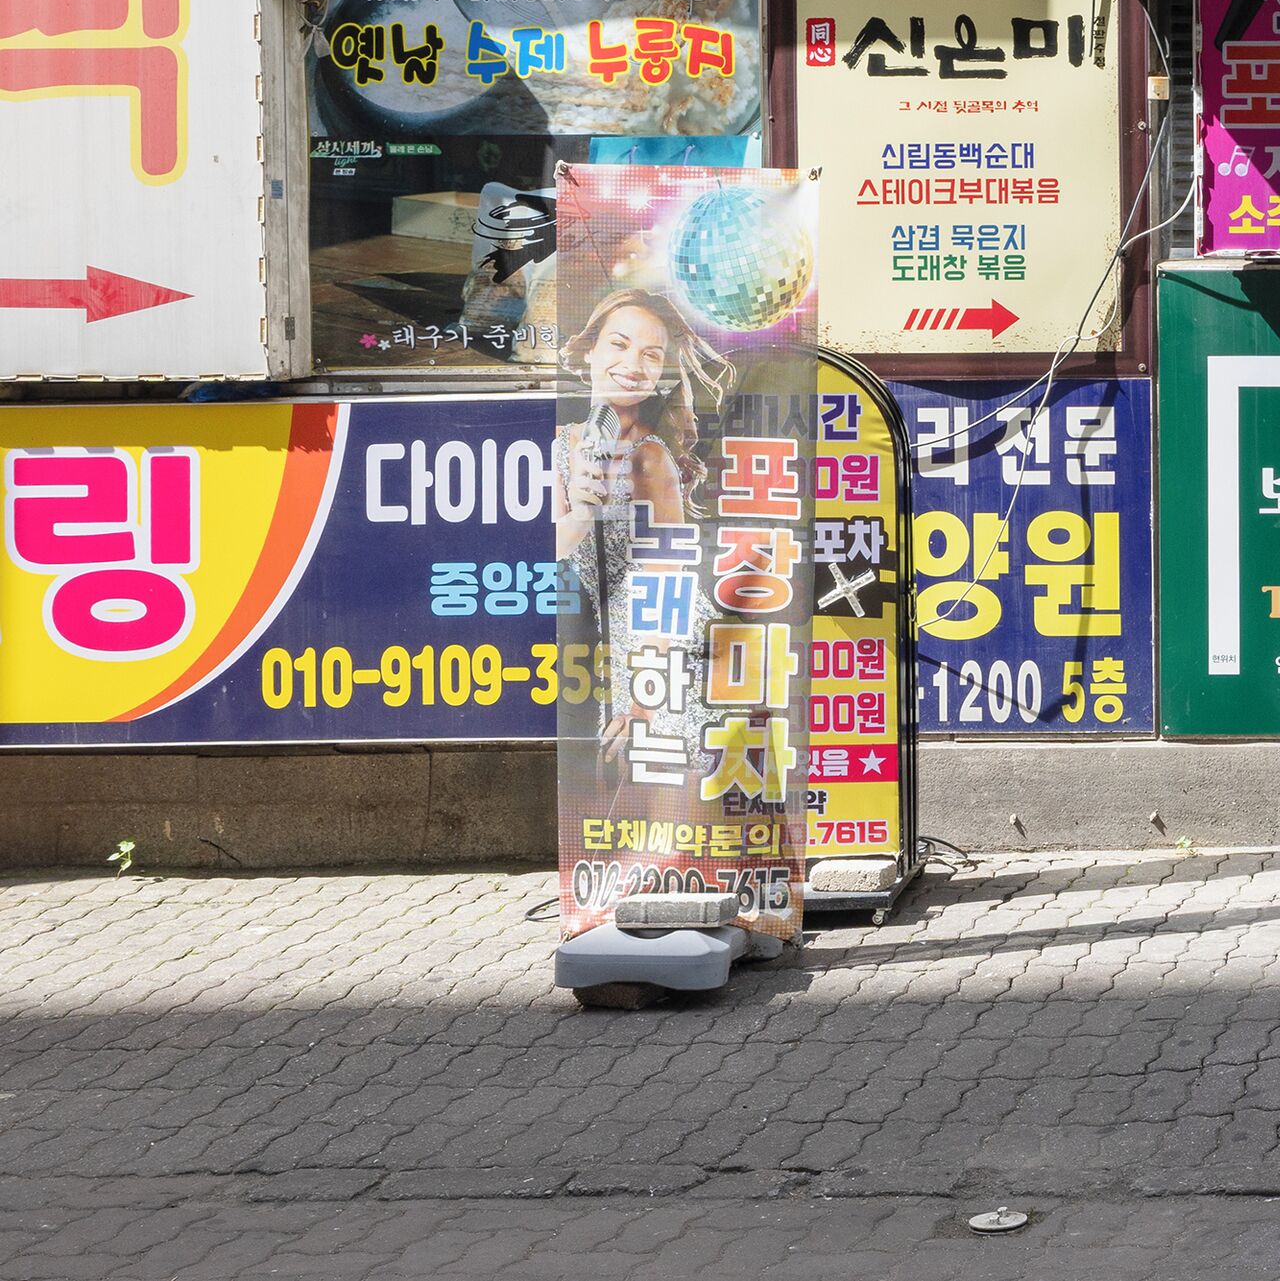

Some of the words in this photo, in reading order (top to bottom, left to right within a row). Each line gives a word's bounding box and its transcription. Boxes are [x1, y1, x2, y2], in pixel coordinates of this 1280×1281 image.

[332, 20, 444, 86] 옛날
[466, 19, 566, 84] 수제
[587, 17, 736, 85] 누룽지
[809, 21, 832, 63] 同心
[953, 100, 1007, 114] 뒷골목의
[1012, 100, 1039, 113] 추억
[881, 143, 1035, 171] 신림동백순대
[856, 178, 1061, 206] 스테이크부대볶음
[891, 224, 940, 252] 삼겹
[951, 224, 1027, 252] 묵은지
[891, 255, 967, 281] 도래창
[977, 255, 1027, 281] 볶음
[995, 405, 1117, 486] 전문
[3, 446, 200, 662] 링
[700, 436, 801, 803] 포장마차
[626, 499, 702, 786] 노래하는
[1211, 654, 1237, 664] 현위치
[1062, 657, 1129, 724] 5층
[583, 818, 781, 858] 단체예약문의
